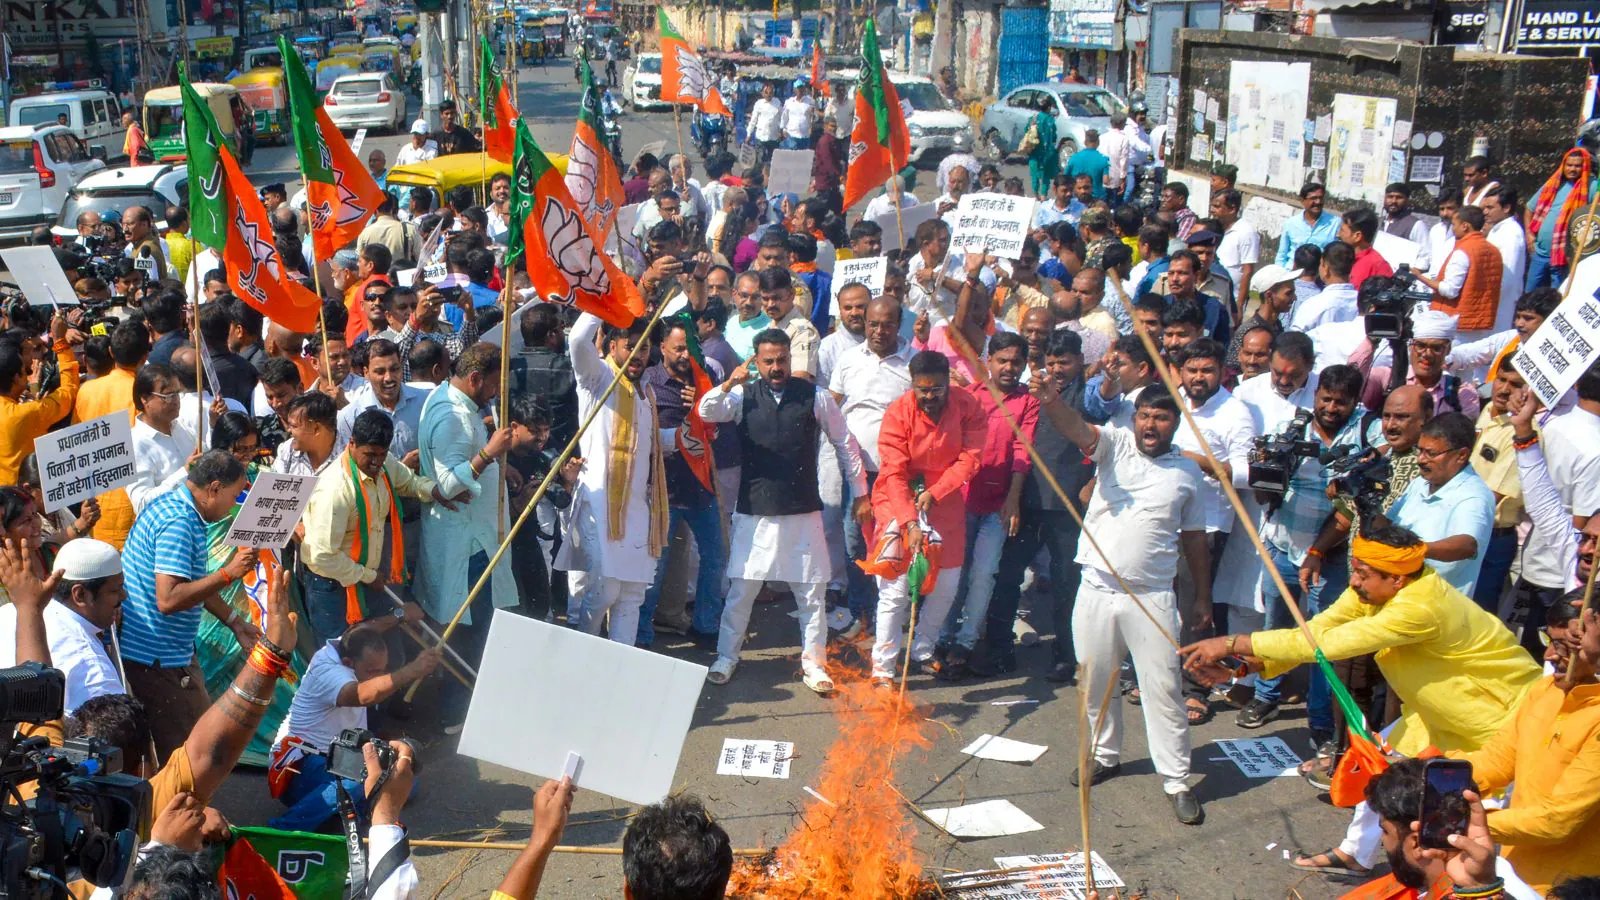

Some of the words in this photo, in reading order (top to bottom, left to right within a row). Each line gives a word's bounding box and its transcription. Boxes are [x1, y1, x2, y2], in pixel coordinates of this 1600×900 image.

[1451, 13, 1488, 26] SEC
[1526, 12, 1578, 25] HAND
[1529, 28, 1542, 40] &
[57, 422, 100, 452] प्रधानमंत्री
[100, 420, 111, 437] के
[47, 454, 77, 479] पिताजी
[77, 452, 90, 468] का
[92, 441, 128, 464] अपमान,
[47, 481, 66, 502] नहीं
[66, 476, 92, 496] सहेगा
[92, 462, 134, 488] हिंदुस्तान!
[255, 497, 275, 509] भाषा
[257, 514, 277, 527] नहीं
[271, 514, 283, 528] तो
[231, 529, 254, 541] जनता
[253, 531, 274, 545] सुधार
[348, 822, 361, 865] SONY
